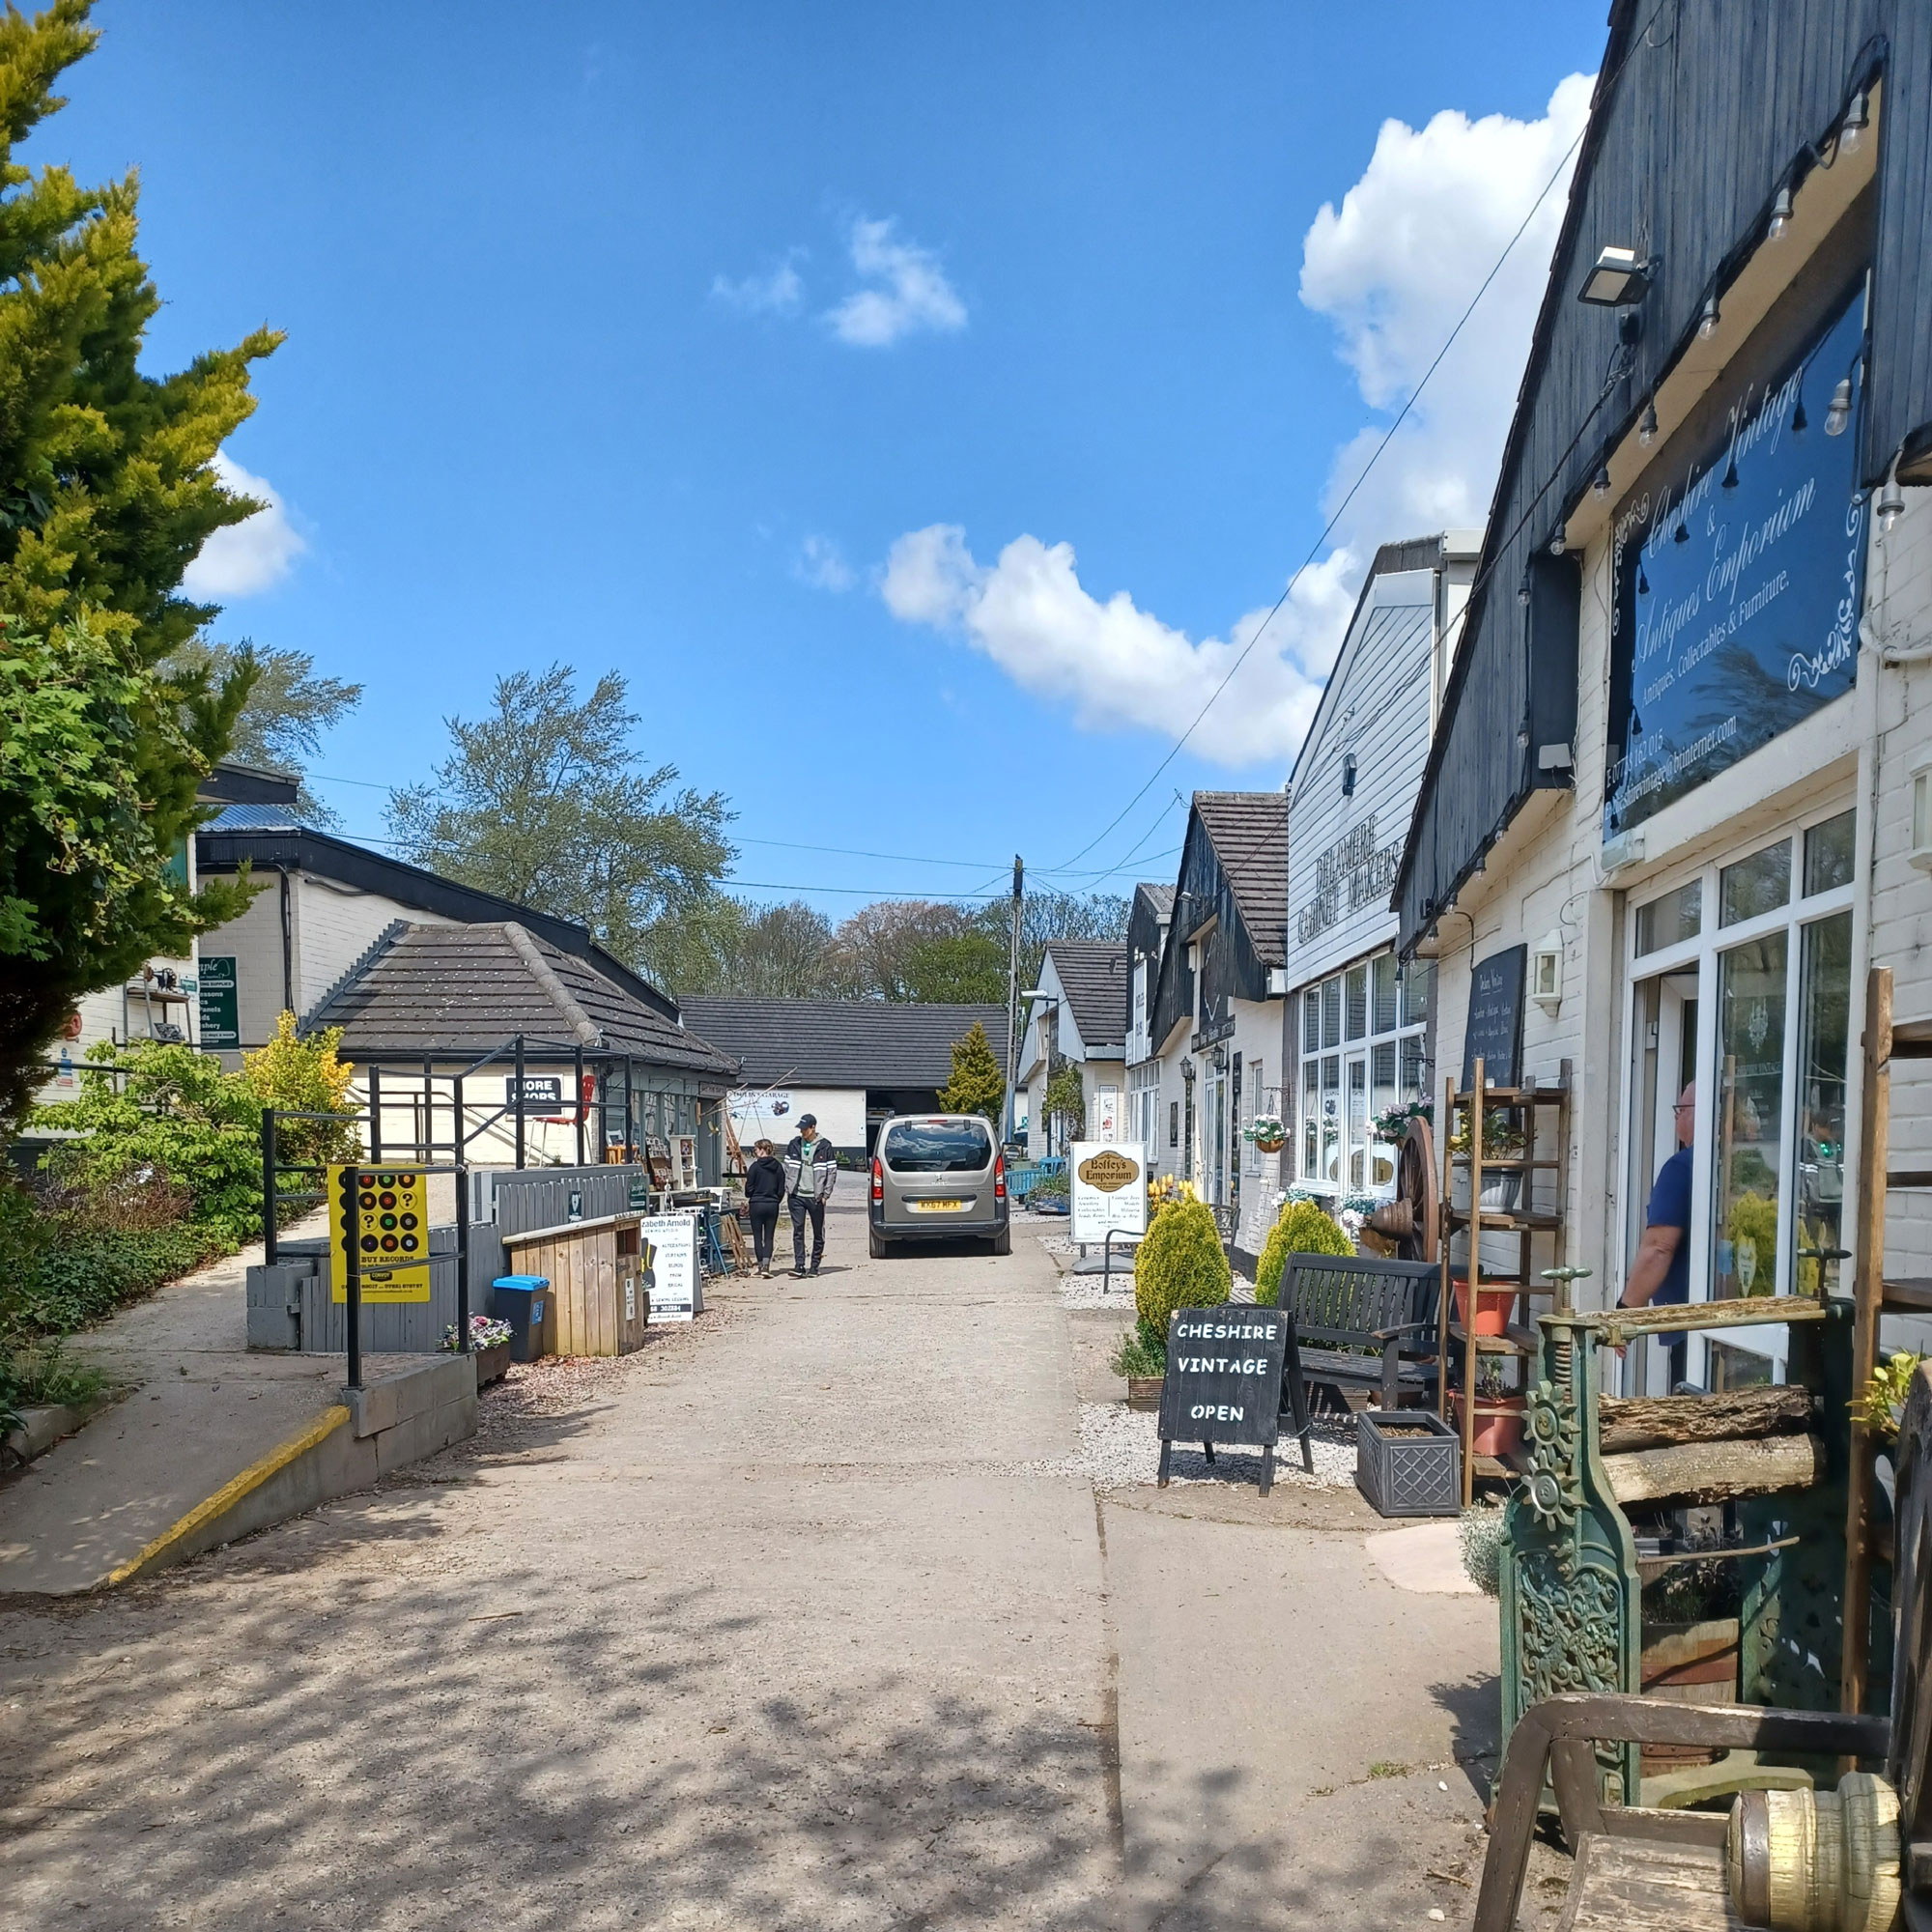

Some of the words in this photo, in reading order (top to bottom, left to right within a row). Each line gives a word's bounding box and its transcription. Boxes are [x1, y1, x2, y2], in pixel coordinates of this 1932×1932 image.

[1647, 464, 1714, 557] Cheshire
[1724, 366, 1803, 475] Vintage
[1707, 505, 1716, 536] &
[1632, 583, 1700, 672] Antiques
[1707, 478, 1816, 606] Emporium
[1678, 622, 1726, 677] Collectables
[1728, 611, 1737, 635] &
[1316, 814, 1378, 894] DELAMERE
[1298, 885, 1340, 944] CABINET
[1348, 840, 1401, 913] MAKERS
[1086, 1170, 1132, 1182] Emporium
[641, 1219, 666, 1228] zabeth
[1178, 1323, 1277, 1340] CHESHIRE
[1178, 1357, 1267, 1375] VINTAGE
[1190, 1405, 1244, 1421] OPEN
